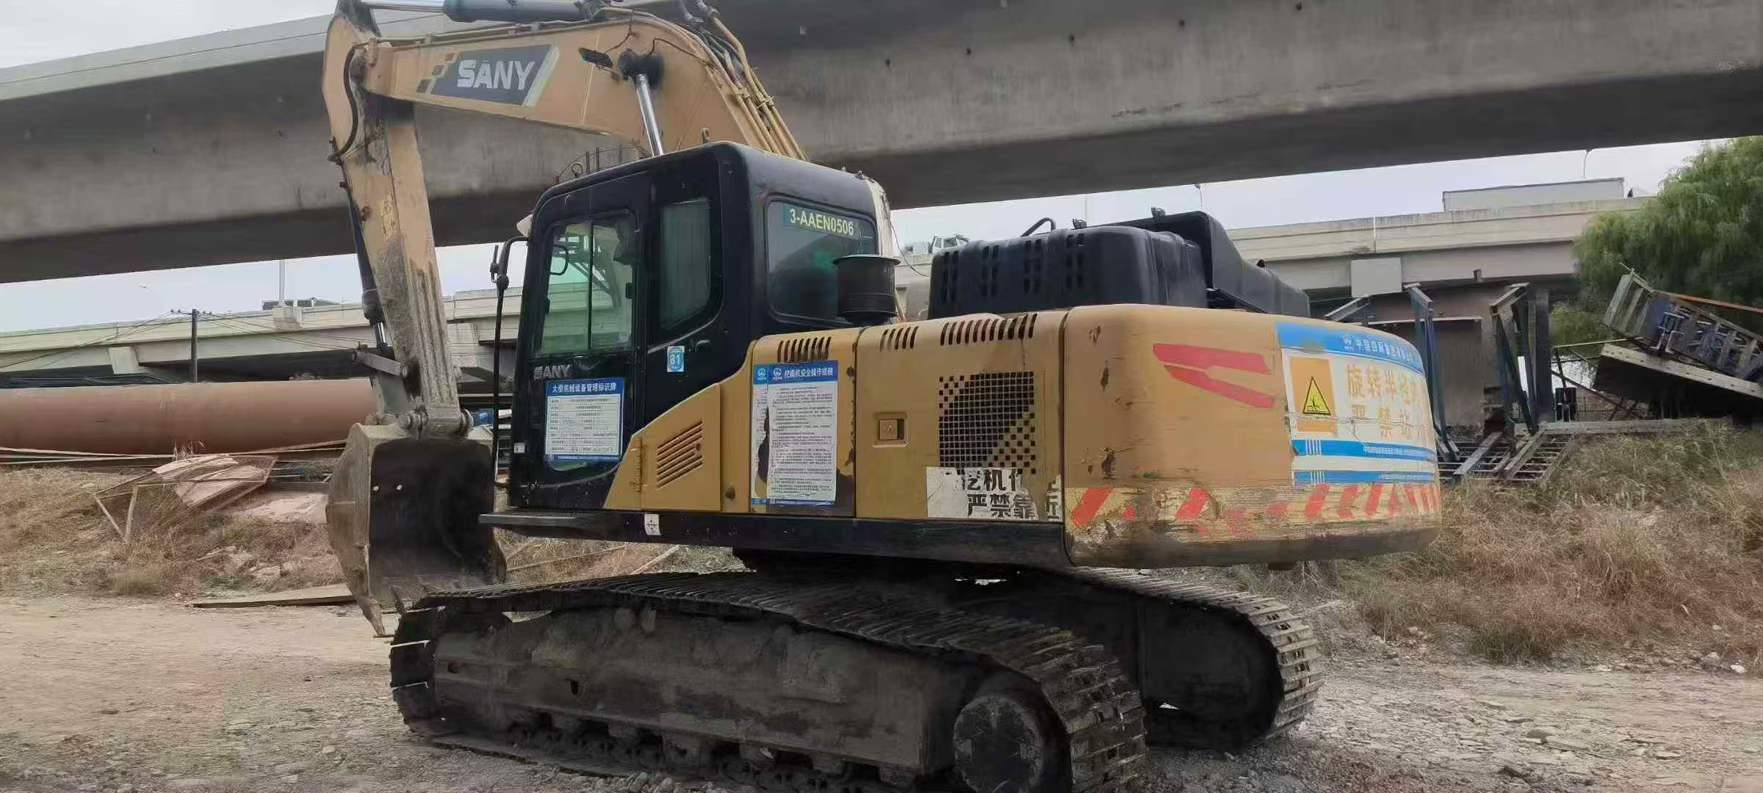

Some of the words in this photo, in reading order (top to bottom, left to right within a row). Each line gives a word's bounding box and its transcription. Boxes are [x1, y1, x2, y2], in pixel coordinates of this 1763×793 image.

[457, 58, 536, 91] SANY
[789, 207, 855, 237] 3-AAEN0506
[533, 363, 572, 381] SANY
